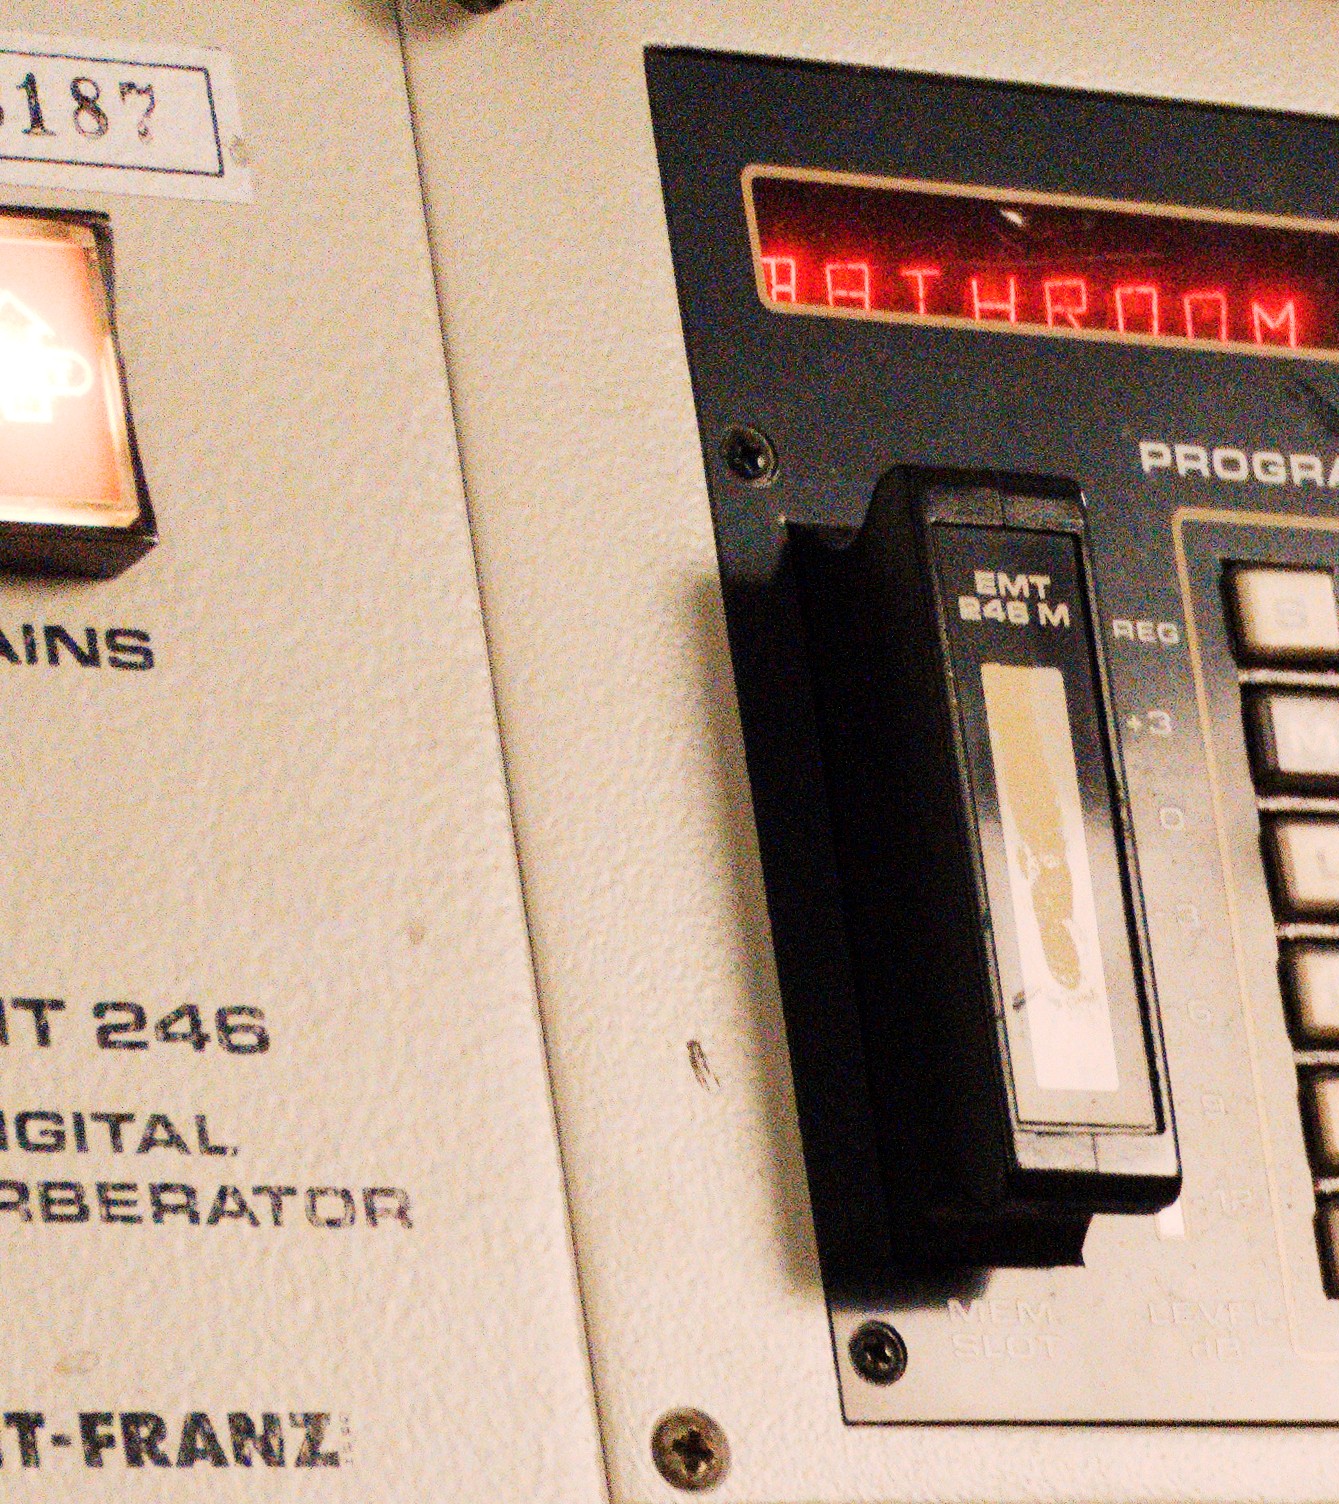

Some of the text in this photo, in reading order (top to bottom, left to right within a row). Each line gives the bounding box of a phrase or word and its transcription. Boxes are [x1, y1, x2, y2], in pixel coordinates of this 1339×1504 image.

[0, 72, 156, 139] 187
[974, 569, 1050, 598] EMT
[93, 1000, 271, 1055] 246
[2, 1411, 340, 1468] T-FRANZ
